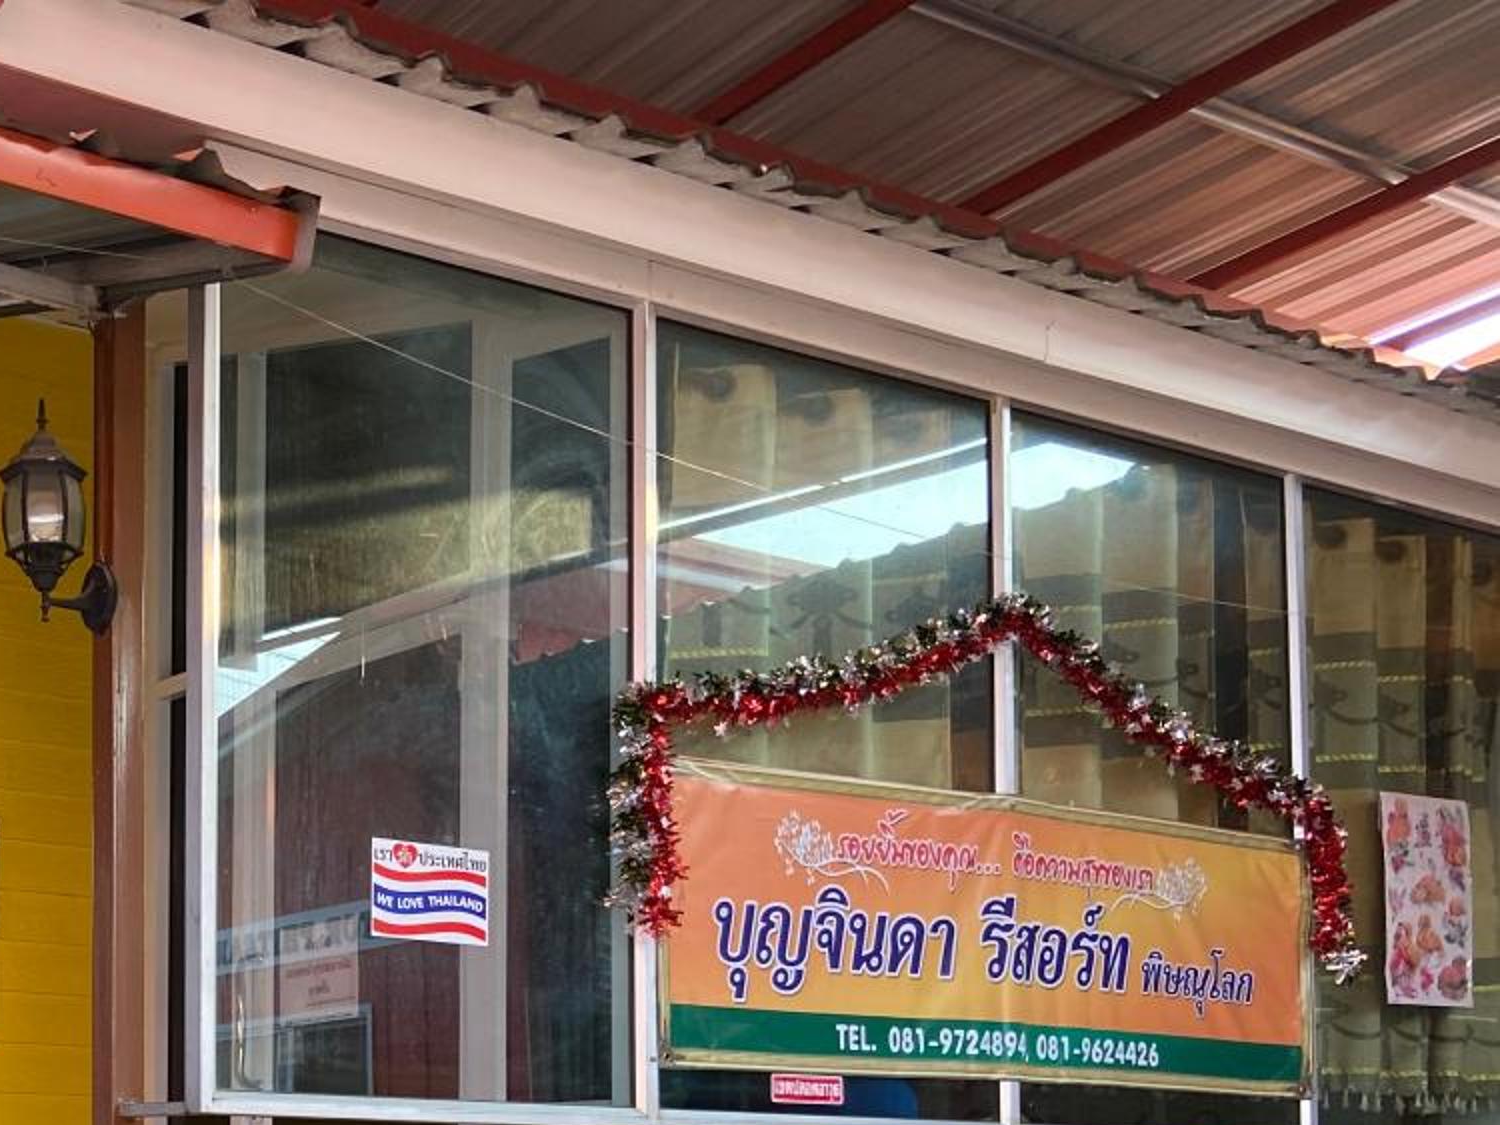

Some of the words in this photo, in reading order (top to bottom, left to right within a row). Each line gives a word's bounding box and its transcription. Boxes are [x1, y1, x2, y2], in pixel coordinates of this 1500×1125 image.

[418, 852, 486, 872] ประเทศไทย
[377, 892, 394, 908] WE
[397, 897, 424, 909] LOVE
[427, 895, 483, 912] THAILAND
[714, 887, 956, 1001] บุญจินดา
[980, 895, 1131, 991] รีสอร์ท
[1141, 950, 1254, 1017] พิษณุโลก
[836, 1023, 877, 1051] TEL.
[1036, 1034, 1159, 1067] 081-9624426
